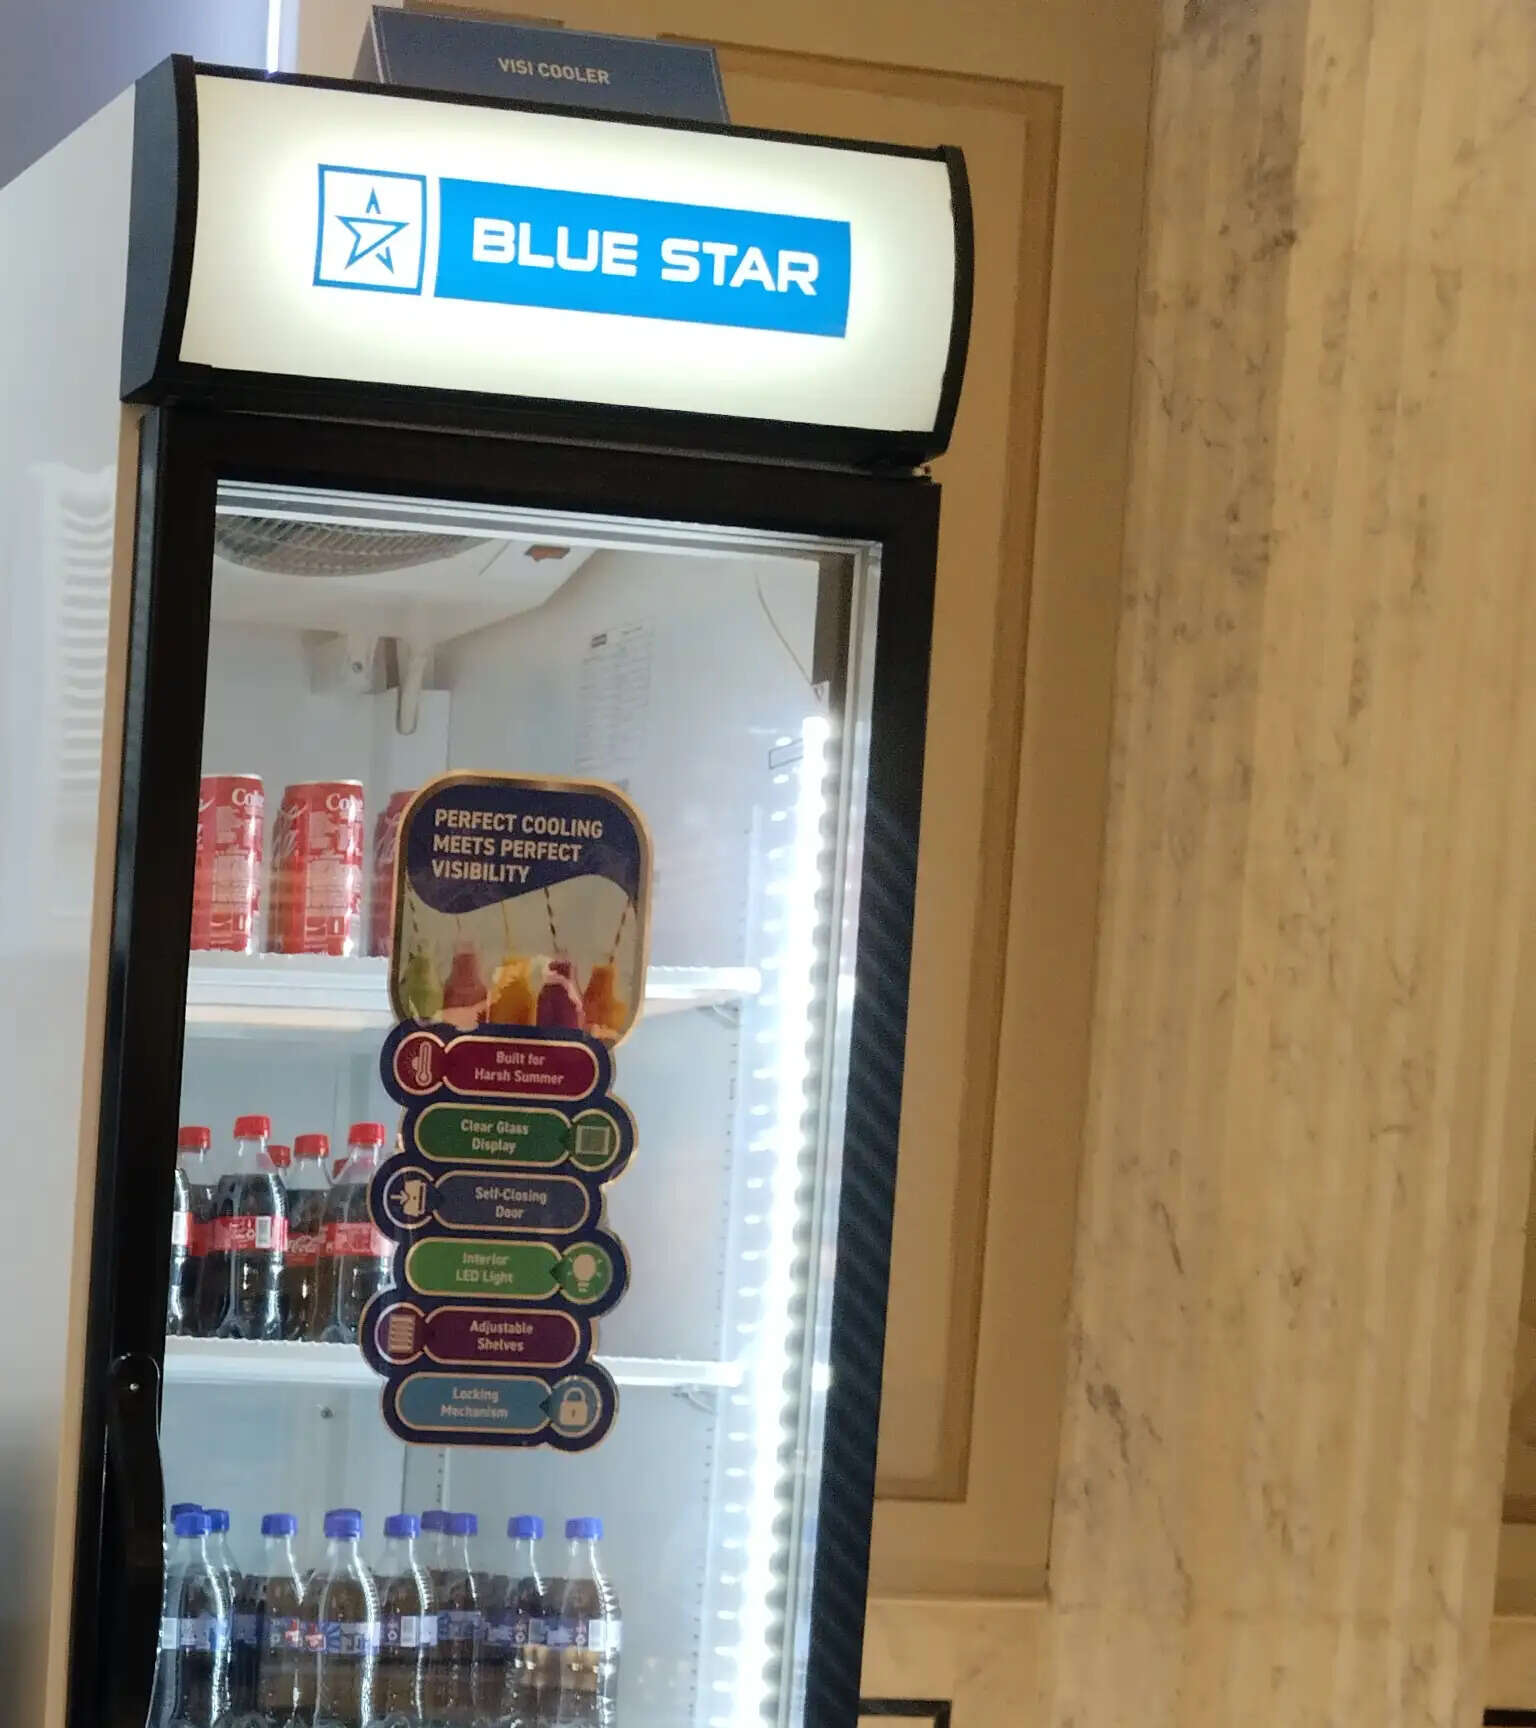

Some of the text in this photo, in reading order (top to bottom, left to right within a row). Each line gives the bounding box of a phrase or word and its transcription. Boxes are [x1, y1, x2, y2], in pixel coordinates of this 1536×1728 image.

[498, 57, 611, 85] VISI COOLER
[472, 216, 820, 295] BLUE STAR
[435, 808, 603, 839] PERFECT COOLING
[433, 835, 583, 862] MEETS PERFECT
[432, 859, 530, 883] VISIBILITY
[496, 1051, 546, 1066] Built for
[474, 1067, 565, 1085] Harsh Summer
[460, 1118, 529, 1135] Clear Glass
[472, 1137, 517, 1155] Display
[475, 1186, 547, 1206] Self-Closing
[495, 1205, 525, 1219] Door
[462, 1252, 510, 1266] Interior
[455, 1268, 514, 1286] LED Light
[470, 1320, 534, 1336] Adjustable
[477, 1337, 525, 1352] Shelves
[452, 1386, 499, 1404] Locking
[440, 1403, 508, 1419] Mechanism
